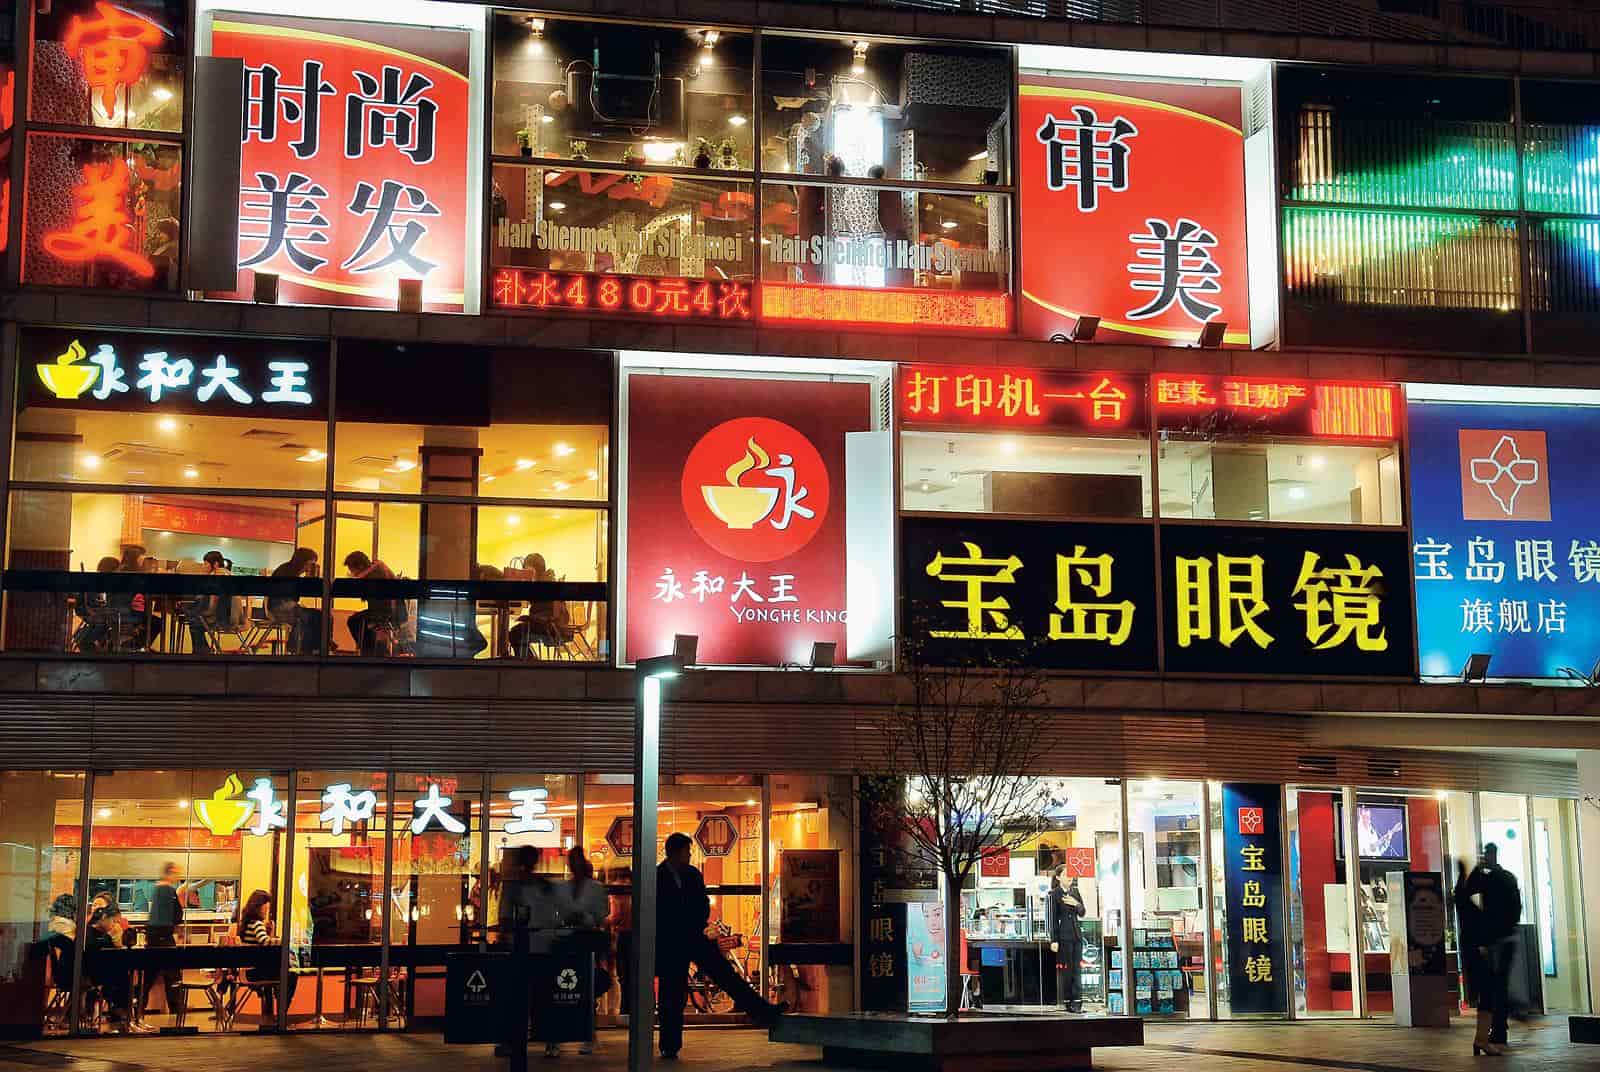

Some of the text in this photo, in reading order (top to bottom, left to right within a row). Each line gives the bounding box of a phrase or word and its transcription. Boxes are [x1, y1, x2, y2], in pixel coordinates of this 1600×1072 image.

[242, 61, 439, 164] 时尚
[239, 172, 442, 275] 美发
[497, 217, 537, 249] Hair
[770, 233, 809, 264] Hair
[897, 239, 932, 270] Hair
[496, 270, 749, 318] 补水480元4次
[90, 344, 313, 405] 永和大王
[907, 371, 1126, 421] 打印机一台
[1412, 536, 1600, 584] 宝岛眼镜
[652, 567, 799, 603] 永和大王
[925, 542, 1388, 651] 宝岛眼镜
[729, 606, 848, 625] YONGHE KING
[1458, 598, 1567, 634] 旗舰店
[246, 777, 555, 836] 永和大王
[1240, 844, 1273, 983] 宝岛眼镜
